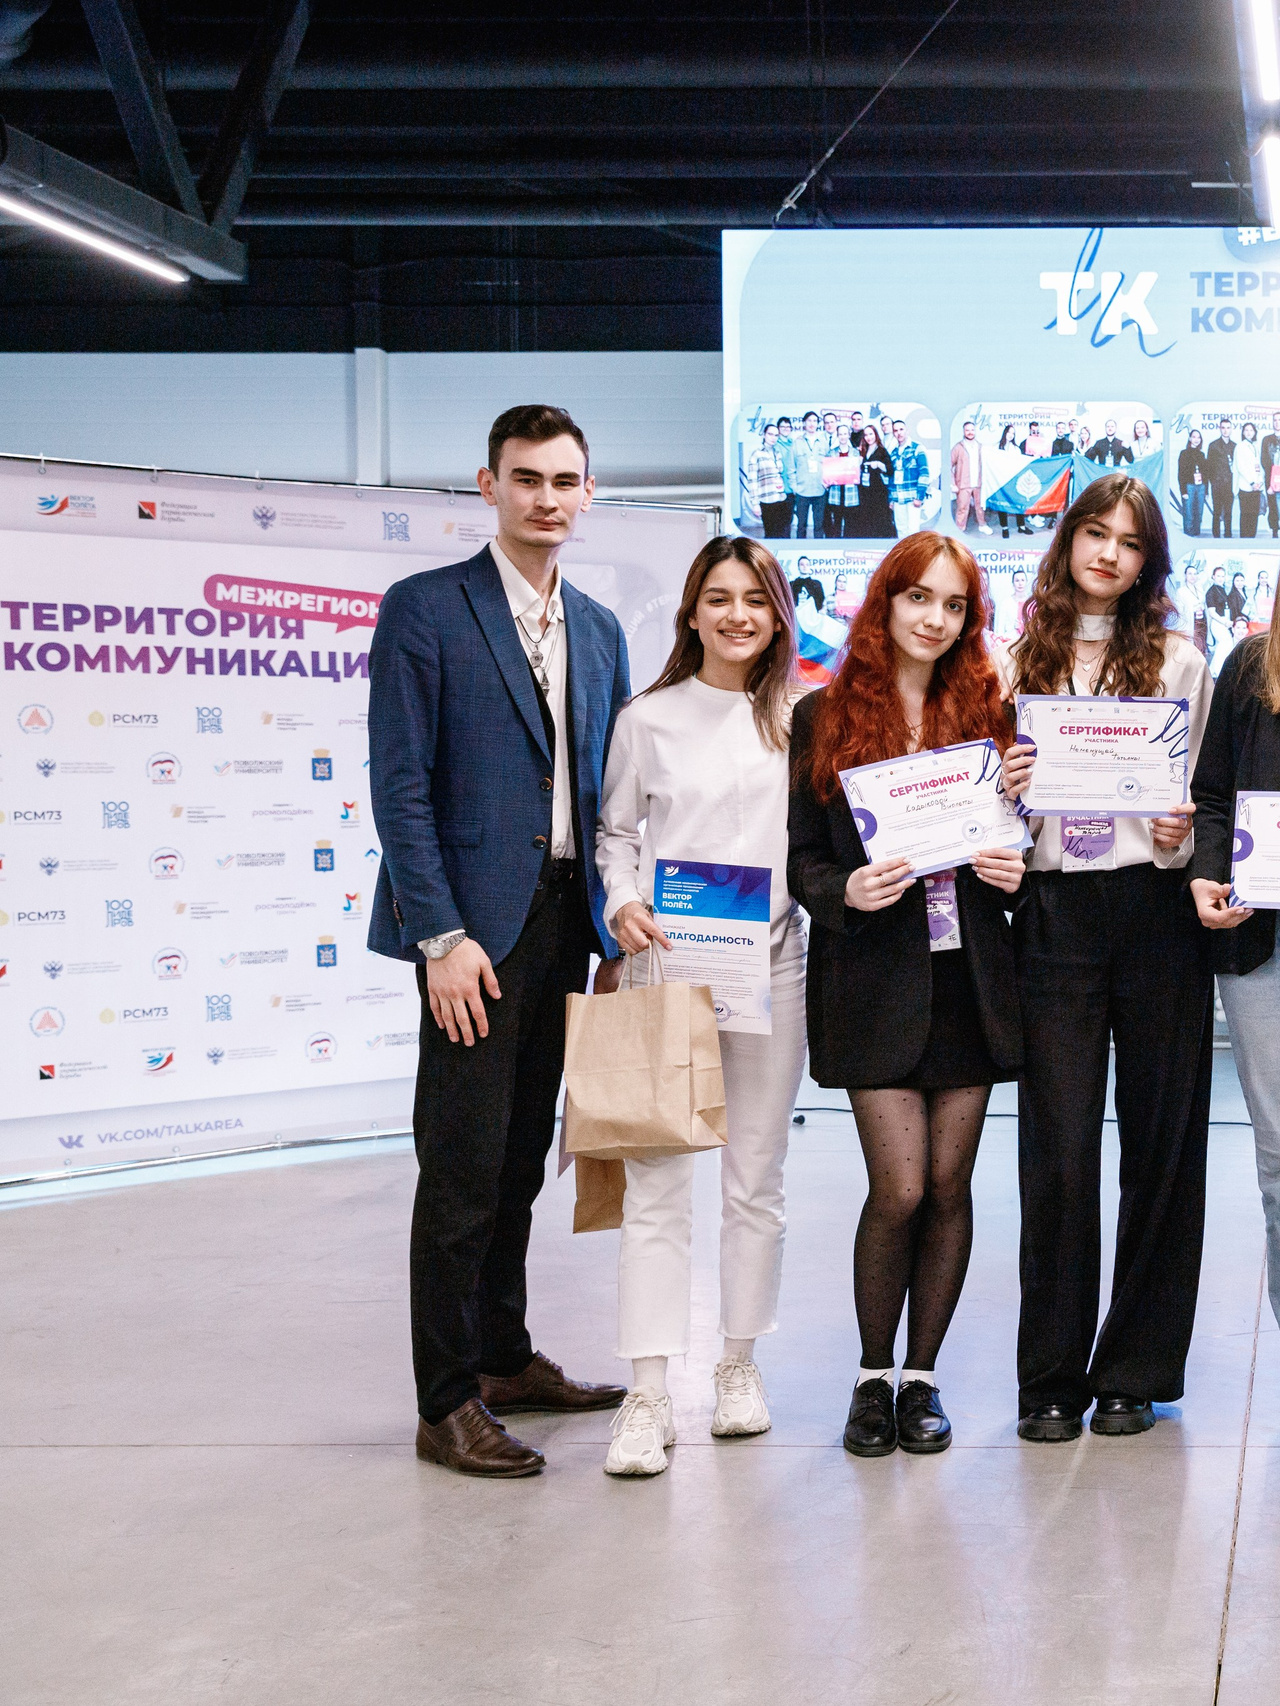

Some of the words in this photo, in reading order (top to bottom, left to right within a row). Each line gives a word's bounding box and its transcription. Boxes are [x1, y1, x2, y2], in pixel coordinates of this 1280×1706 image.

[0, 600, 305, 640] ТЕРРИТОРИЯ
[3, 641, 370, 683] КОММУНИКАЦИ
[112, 713, 159, 726] РСМ73
[1059, 724, 1149, 738] СЕРТИФИКАТ
[889, 771, 970, 799] СЕРТИФИКАТ
[915, 788, 949, 800] УЧАСТНИКА
[13, 810, 62, 822] РСМ73
[662, 892, 692, 901] ВЕКТОР
[926, 891, 950, 900] СТНИК
[661, 900, 693, 910] ПОЛЁТА
[17, 910, 67, 923] РСМ73
[123, 1006, 170, 1020] РСМ73
[97, 1118, 244, 1145] VK.COM/TALKAREA
